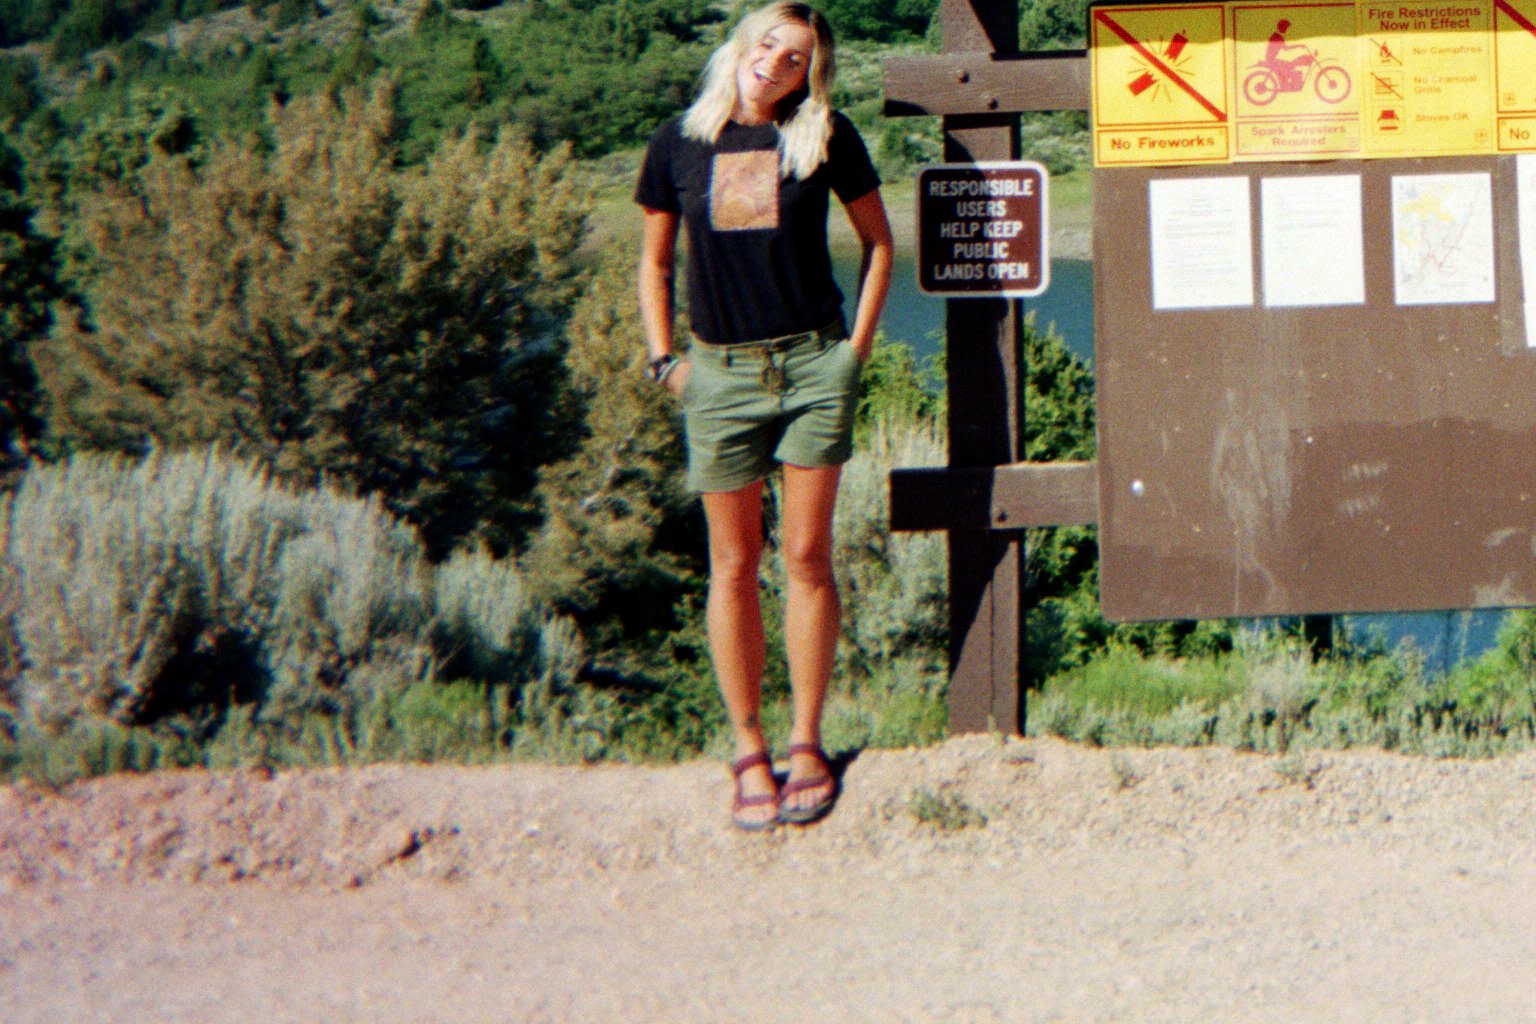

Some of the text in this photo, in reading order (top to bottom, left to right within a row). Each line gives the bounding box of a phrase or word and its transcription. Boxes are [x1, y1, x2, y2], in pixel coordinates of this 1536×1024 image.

[1368, 6, 1481, 20] Fire Restrictions
[1380, 18, 1470, 31] Now in Effect
[1413, 45, 1482, 56] No Campfires
[1414, 76, 1428, 84] No
[1252, 126, 1284, 137] Spark
[1509, 128, 1530, 140] No
[1111, 136, 1215, 150] No Fireworks
[1272, 137, 1325, 147] Required
[929, 179, 1034, 196] RESPONSIBLE
[956, 200, 1007, 217] USERS
[940, 220, 1023, 238] HELP KEEP
[953, 241, 1009, 258] PUBLIC
[934, 262, 1029, 280] LANDS OPEN
